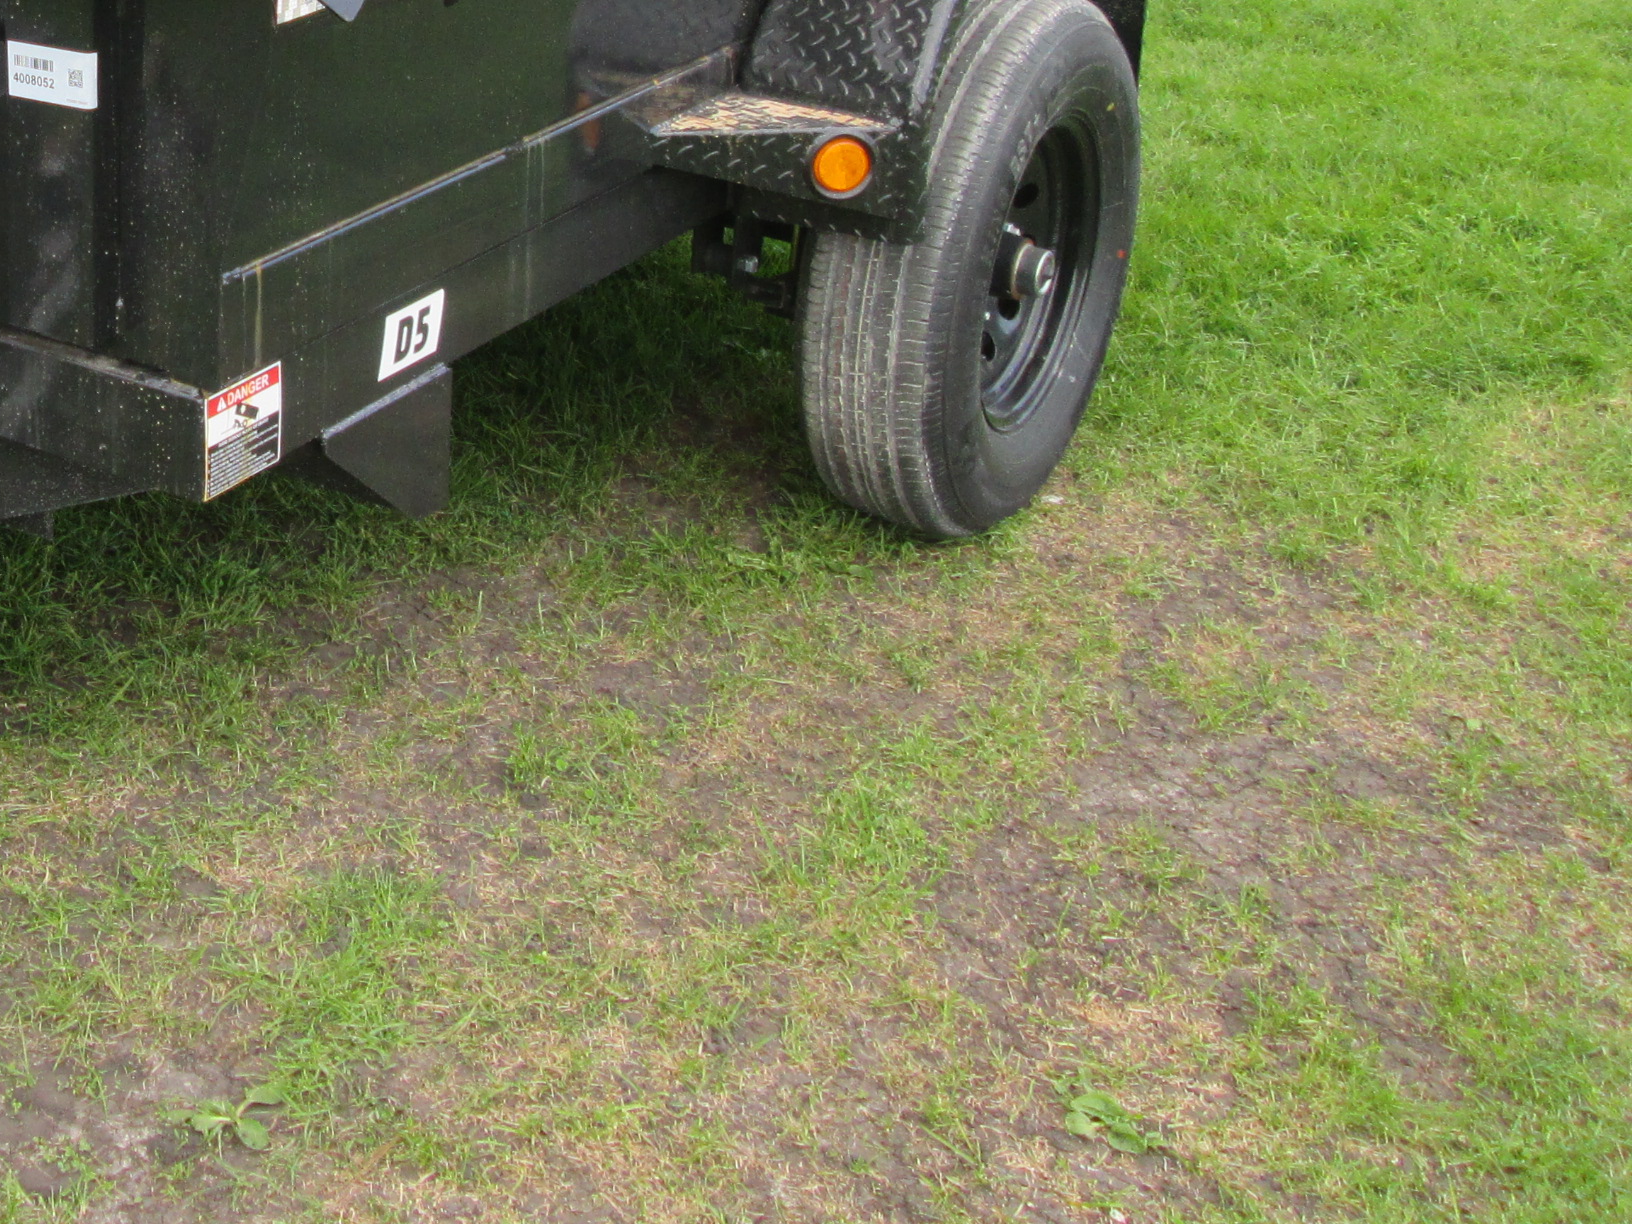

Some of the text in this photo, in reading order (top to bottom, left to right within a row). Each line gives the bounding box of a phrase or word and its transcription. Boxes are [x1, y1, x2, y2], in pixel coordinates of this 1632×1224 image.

[13, 72, 55, 89] 4008052
[393, 304, 431, 365] D5
[227, 373, 270, 406] DANGER
